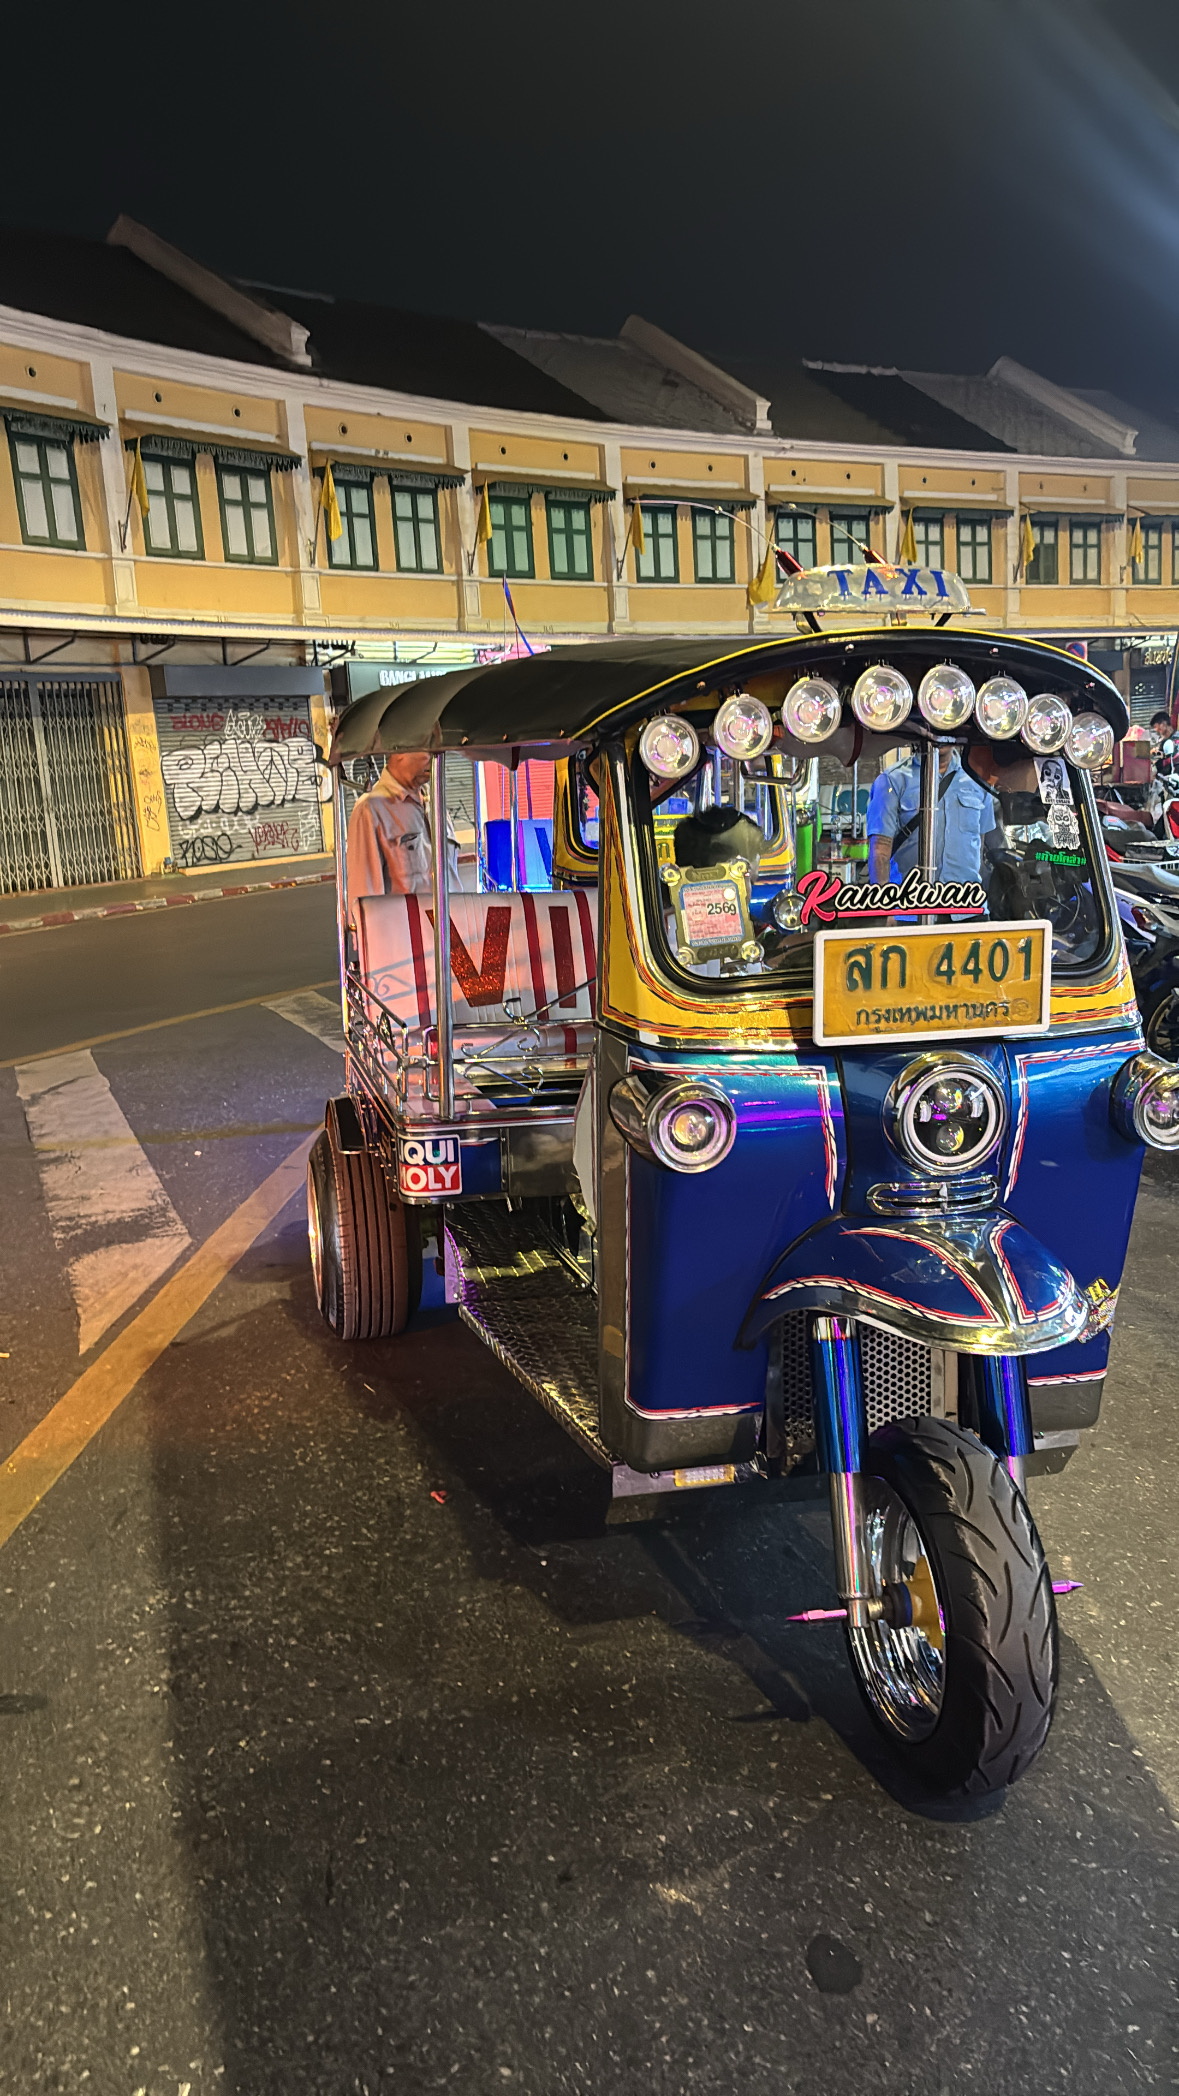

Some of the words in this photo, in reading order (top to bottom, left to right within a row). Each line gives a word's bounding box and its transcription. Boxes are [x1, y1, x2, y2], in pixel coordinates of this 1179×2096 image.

[827, 567, 950, 600] TAXI
[706, 902, 737, 916] 2569
[797, 868, 987, 926] Kanokwan
[845, 943, 907, 992] สก
[935, 936, 1032, 986] 4401
[856, 1001, 1011, 1032] กรุงเทพมหานคร
